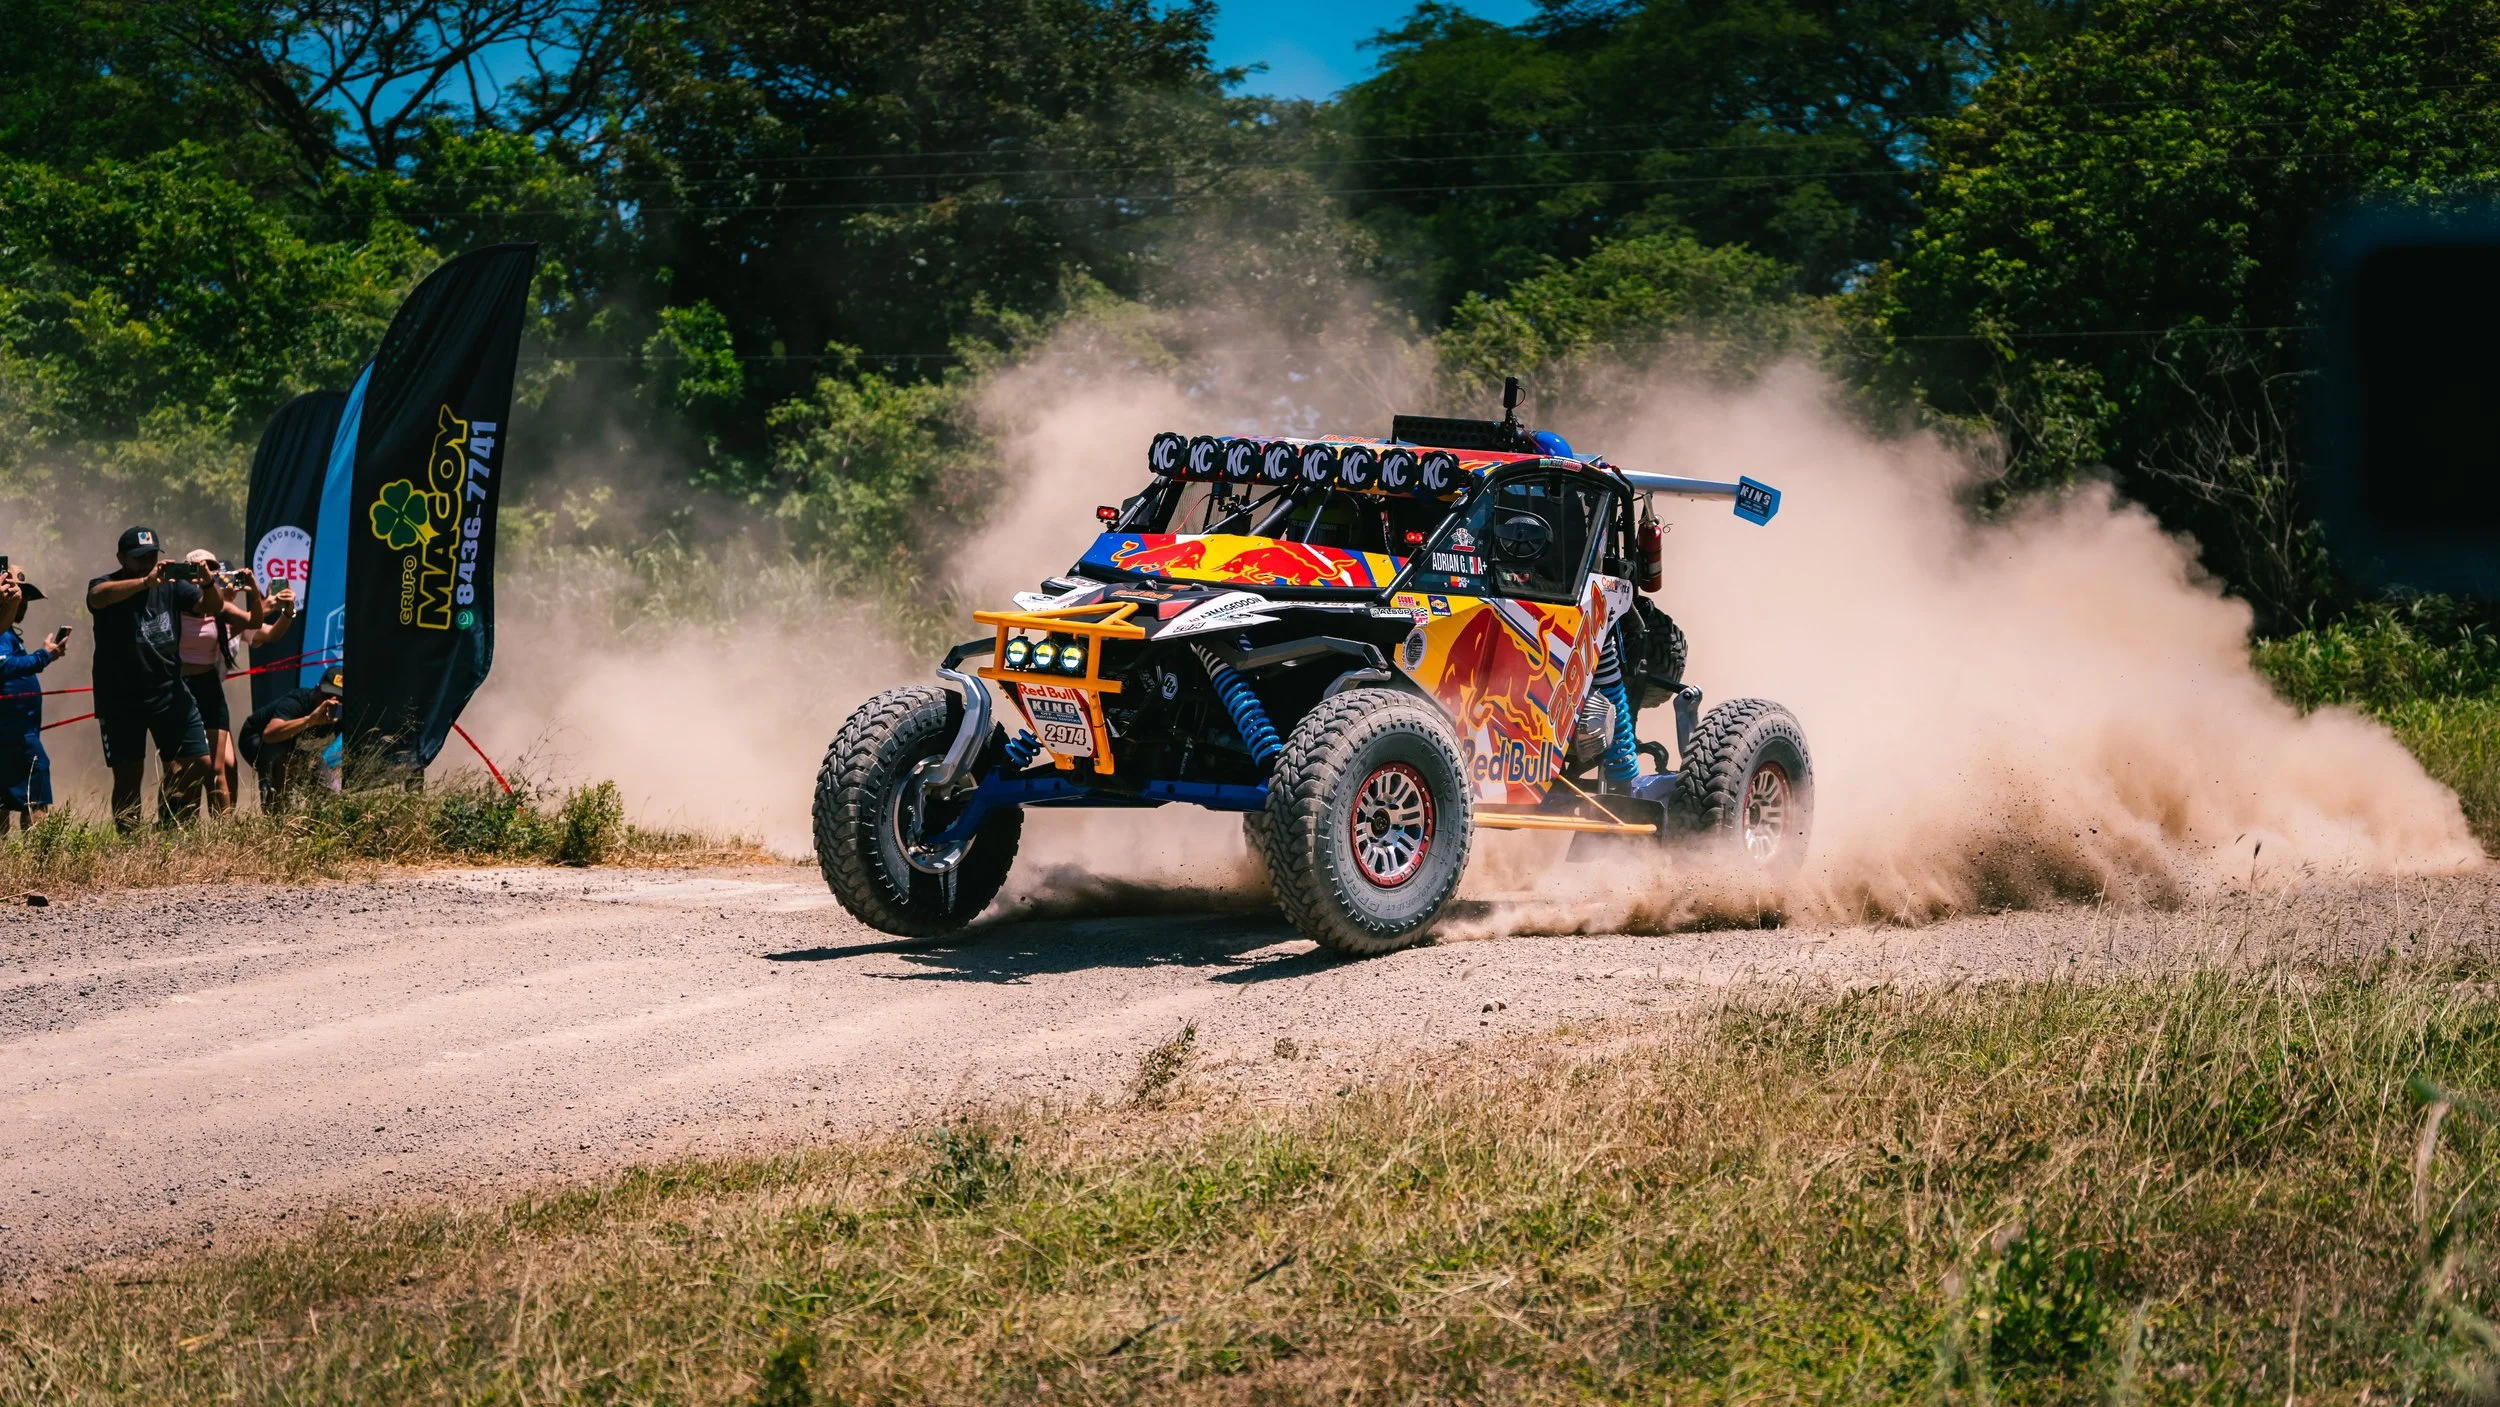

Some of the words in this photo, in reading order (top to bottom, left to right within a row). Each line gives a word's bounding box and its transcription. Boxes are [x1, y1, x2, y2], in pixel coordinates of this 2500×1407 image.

[1153, 438, 1177, 470] KC
[1189, 441, 1214, 474] KC
[1226, 444, 1251, 477] KC
[1263, 446, 1289, 479] KC
[1302, 449, 1328, 482] KC
[1341, 452, 1368, 485] KC
[1381, 454, 1408, 487] KC
[1422, 457, 1449, 490] KC
[1740, 485, 1771, 506] KING
[417, 404, 467, 629] MACOY
[457, 421, 496, 605] 8436-7741
[256, 544, 268, 584] GLOBAL
[268, 530, 304, 544] ESCROW
[266, 558, 309, 582] GES
[1432, 552, 1460, 573] ADRIAN
[1460, 555, 1468, 573] G.
[1477, 556, 1488, 575] A+
[400, 555, 417, 624] GRUPO
[1200, 596, 1262, 619] ARMAGEDDON
[1549, 581, 1607, 748] 2974
[1018, 683, 1047, 697] Red
[1046, 686, 1075, 700] Bull
[1031, 700, 1076, 714] KING
[1045, 724, 1086, 746] 2974
[1507, 737, 1554, 785] Bull
